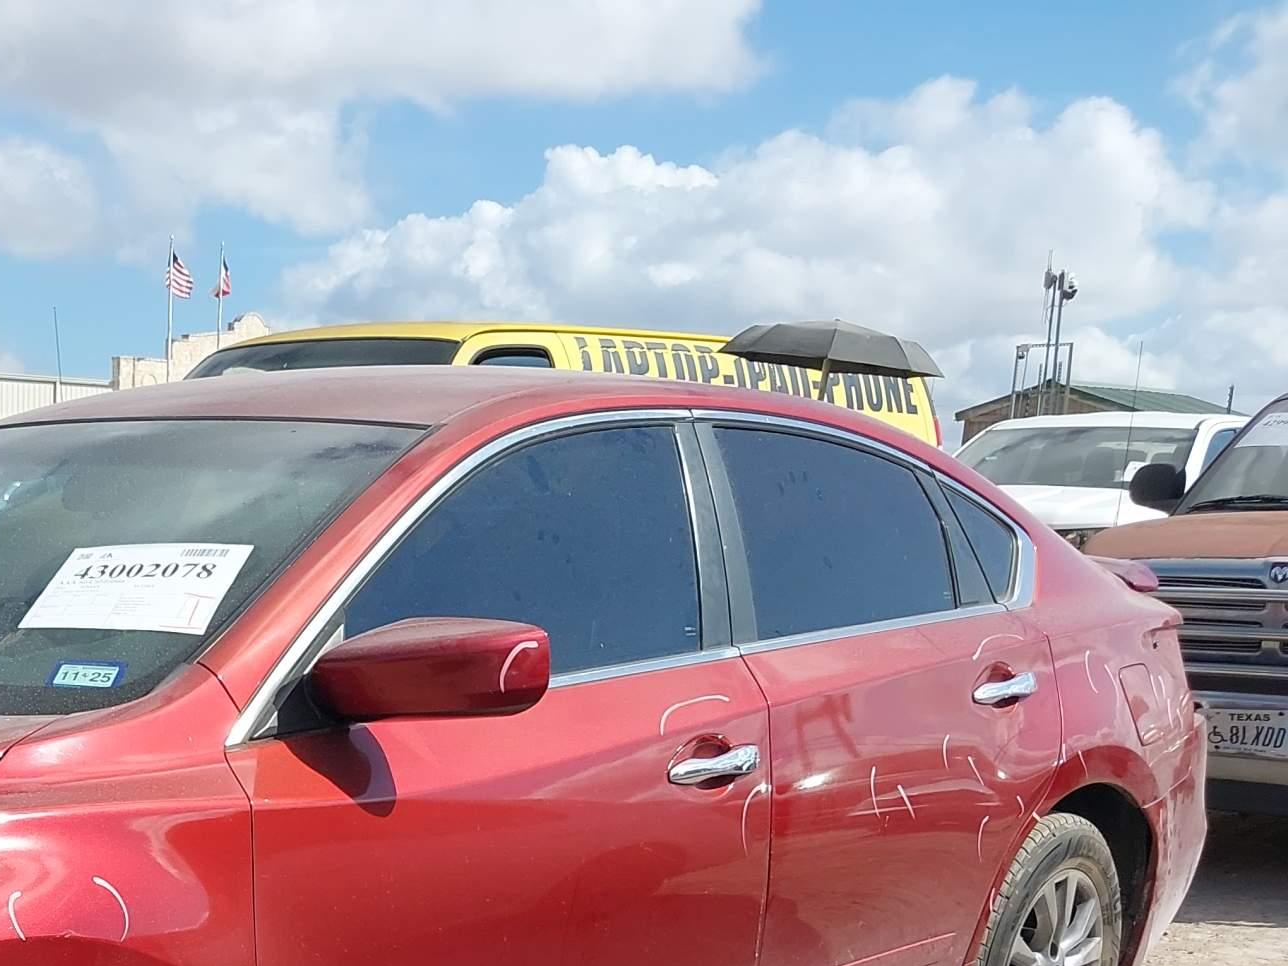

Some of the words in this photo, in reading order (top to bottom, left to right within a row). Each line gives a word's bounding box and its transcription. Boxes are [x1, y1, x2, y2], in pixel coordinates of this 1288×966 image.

[74, 563, 216, 579] 43002078
[89, 671, 113, 683] 25
[1229, 713, 1271, 722] TEXAS
